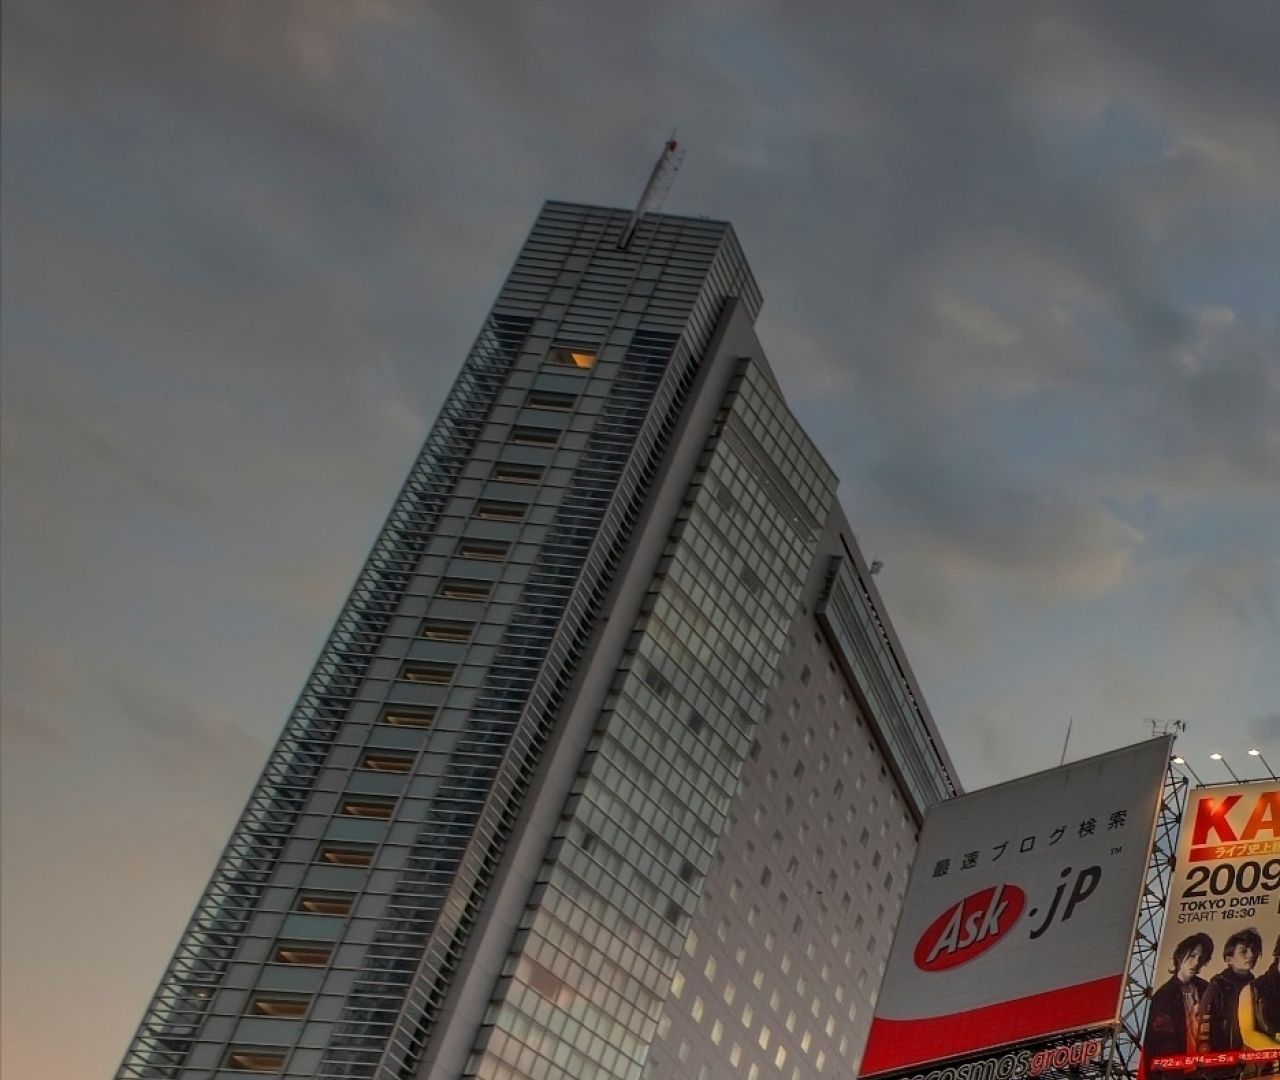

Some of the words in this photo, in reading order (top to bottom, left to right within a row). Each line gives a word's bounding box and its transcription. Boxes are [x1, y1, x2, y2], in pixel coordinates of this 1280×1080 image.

[933, 810, 1127, 878] 最速ブログ検索
[1177, 911, 1216, 924] START
[1221, 907, 1255, 920] 18:30
[1180, 897, 1225, 912] TOKYO
[1228, 894, 1270, 909] DOME
[1030, 1040, 1101, 1077] group
